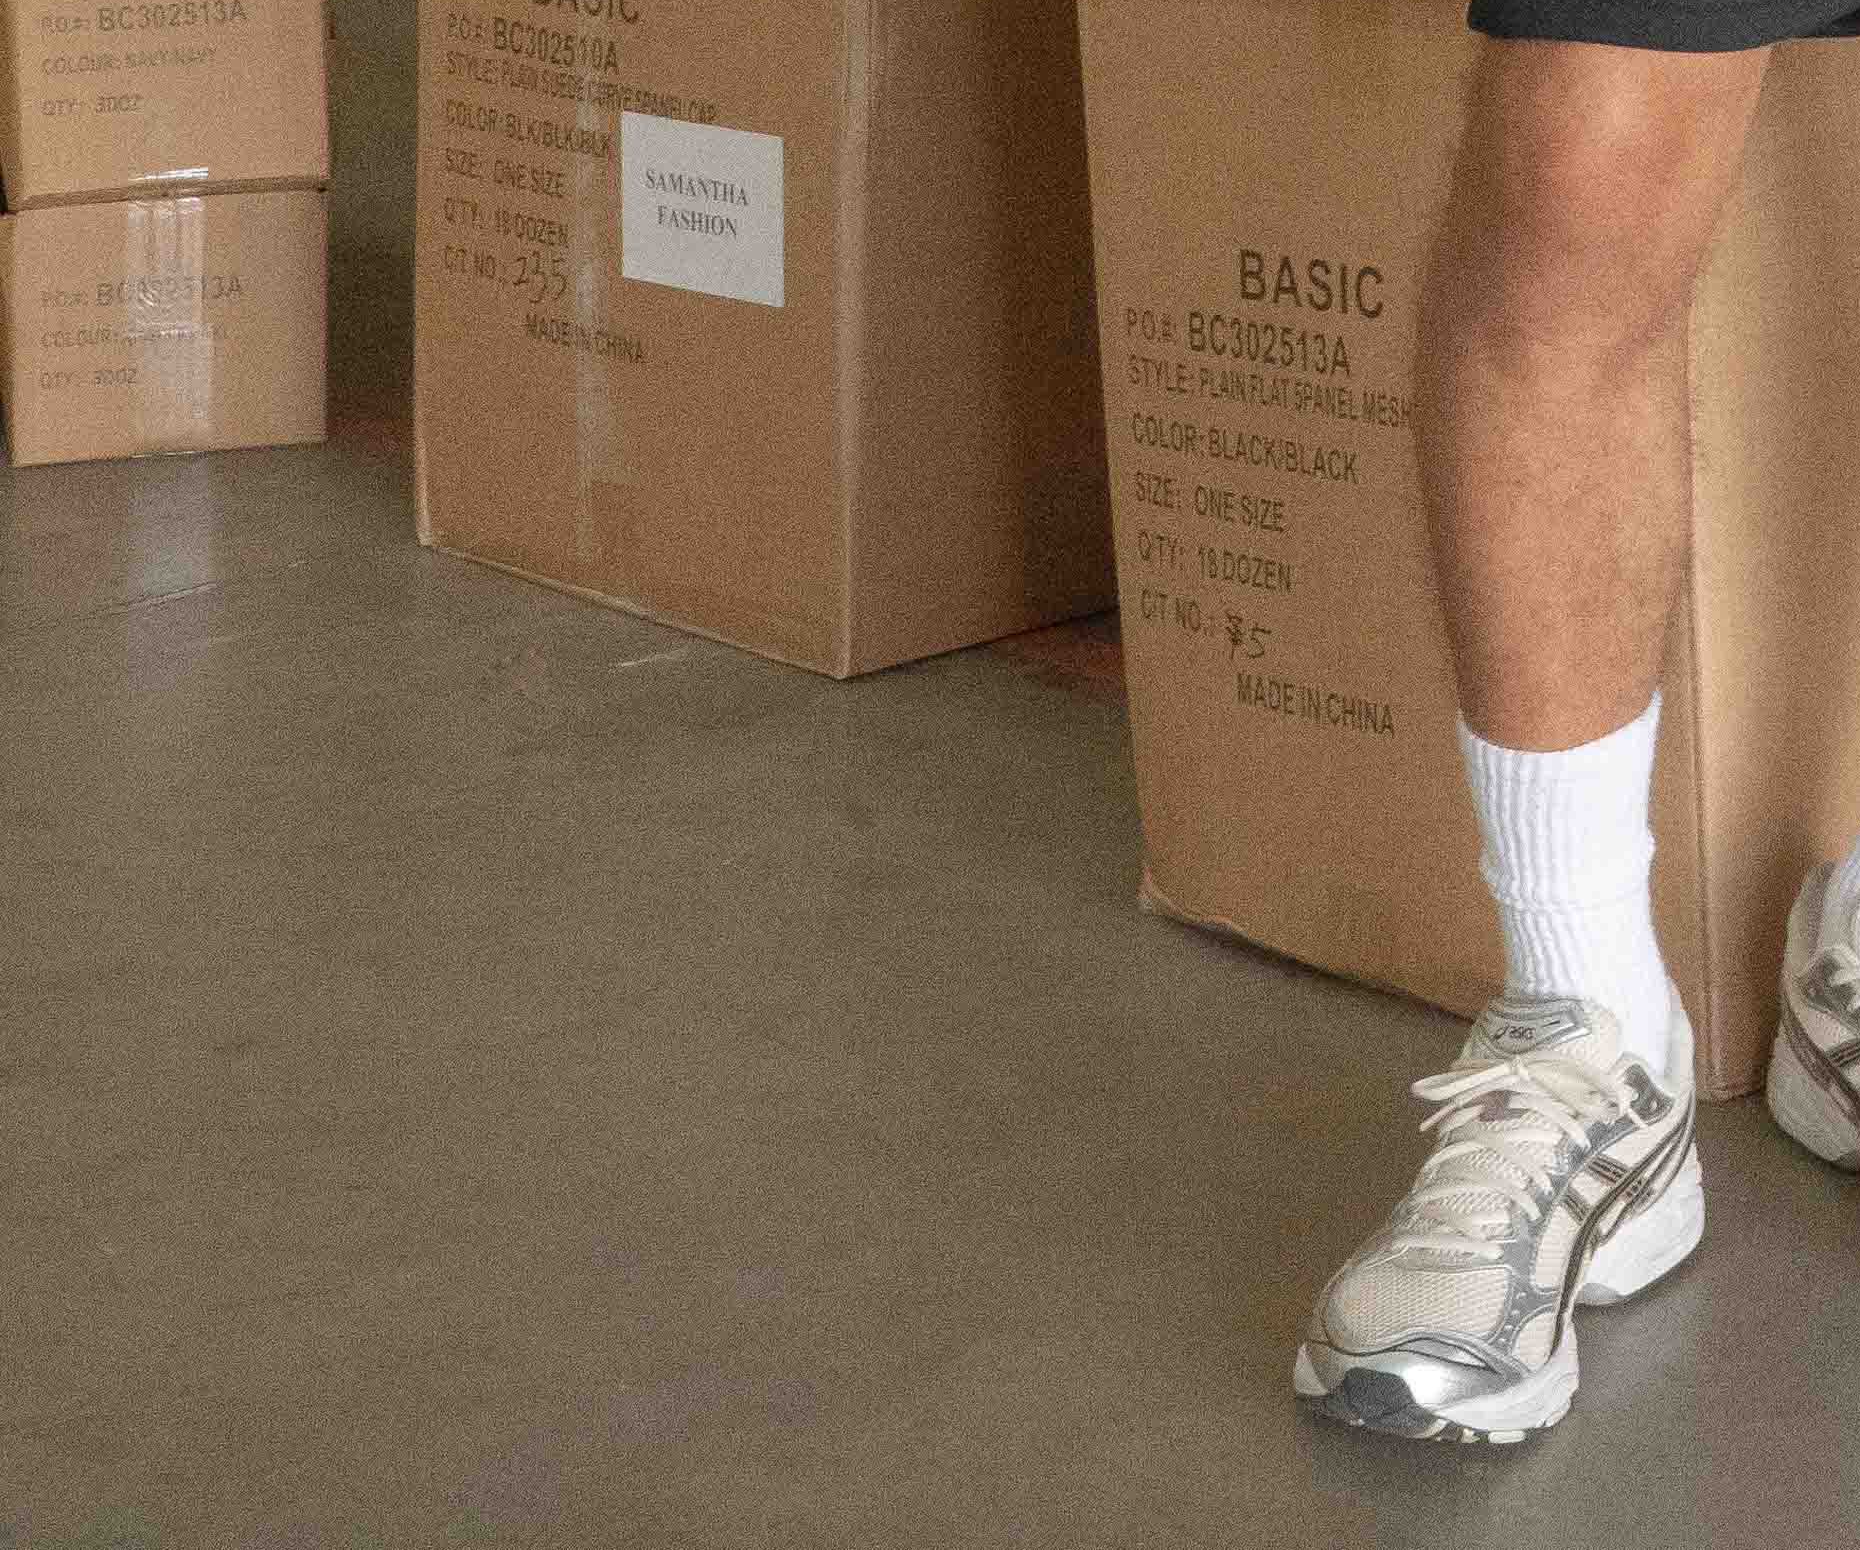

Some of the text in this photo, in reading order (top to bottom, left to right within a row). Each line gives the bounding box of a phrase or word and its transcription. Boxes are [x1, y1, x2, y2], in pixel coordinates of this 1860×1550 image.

[96, 0, 248, 32] BC302513A
[493, 17, 621, 75] BC302510A
[645, 168, 750, 207] SAMANTHA
[656, 204, 738, 238] FASHION
[1237, 249, 1383, 319] BASIC
[1188, 311, 1350, 377] BC302513A
[1128, 354, 1194, 395] STYLE:
[1199, 368, 1247, 401] PLAIN
[1250, 373, 1289, 408] FLAT
[1131, 412, 1359, 485] COLOR: BLACK/BLACK
[1135, 471, 1285, 533] SIZE: ONE SIZE
[1198, 546, 1218, 580] 18
[1223, 550, 1293, 593] DOZEN
[1236, 672, 1395, 737] MADE IN CHINA
